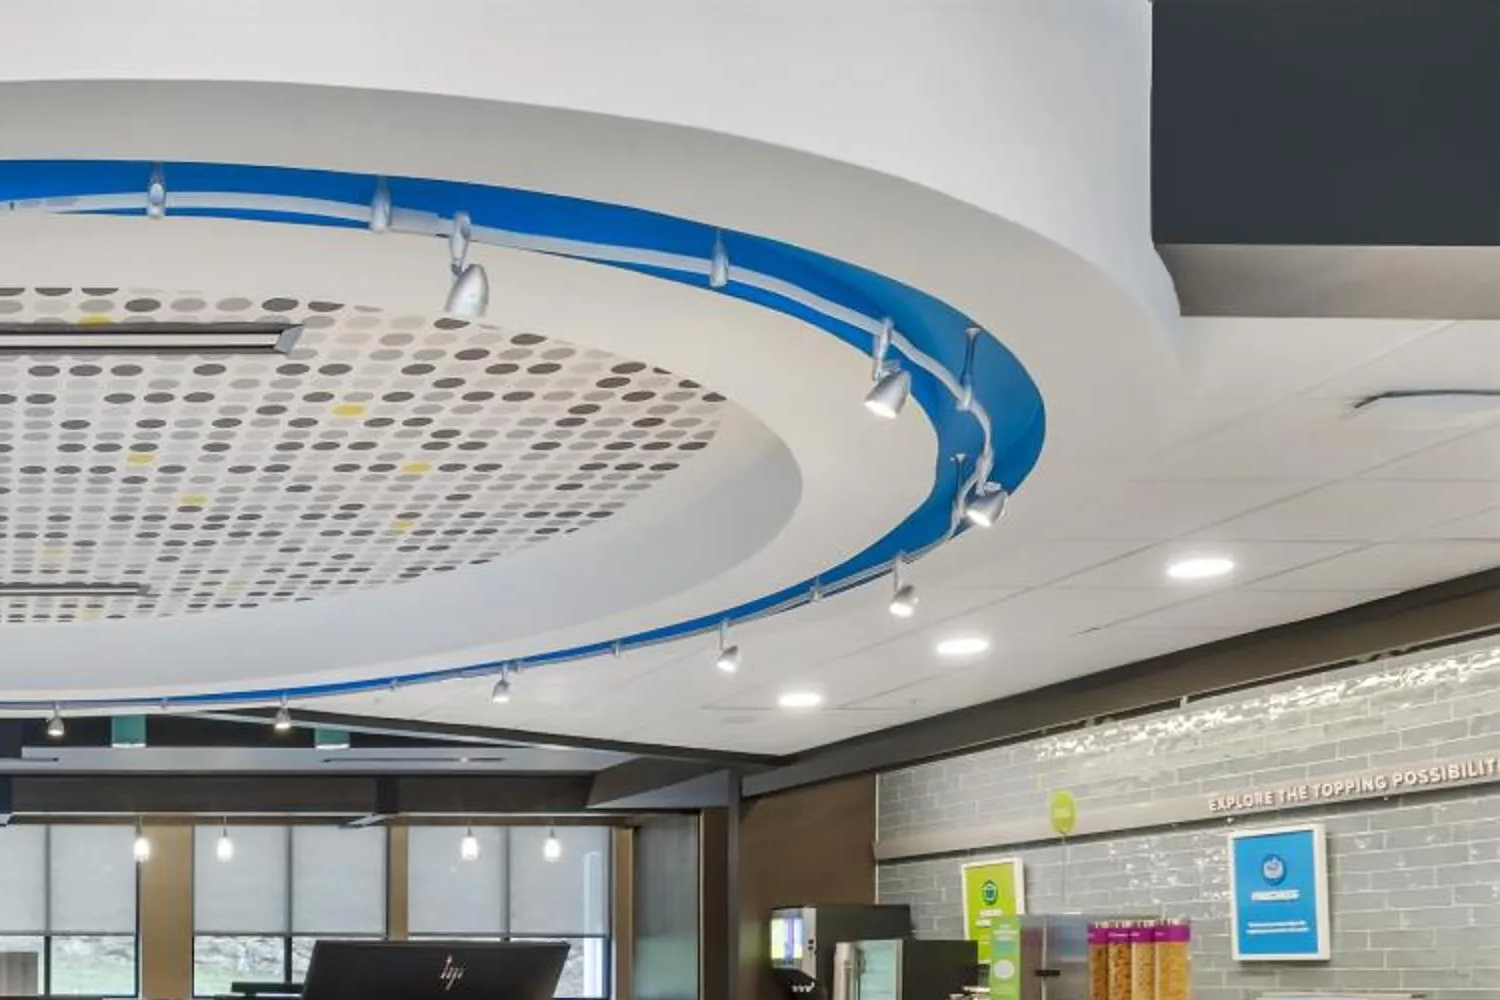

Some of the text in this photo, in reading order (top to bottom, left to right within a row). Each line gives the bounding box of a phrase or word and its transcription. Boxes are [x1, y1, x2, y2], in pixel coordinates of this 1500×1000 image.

[1209, 791, 1273, 812] EXPLORE
[1279, 785, 1308, 804] THE
[1311, 775, 1388, 800] TOPPING
